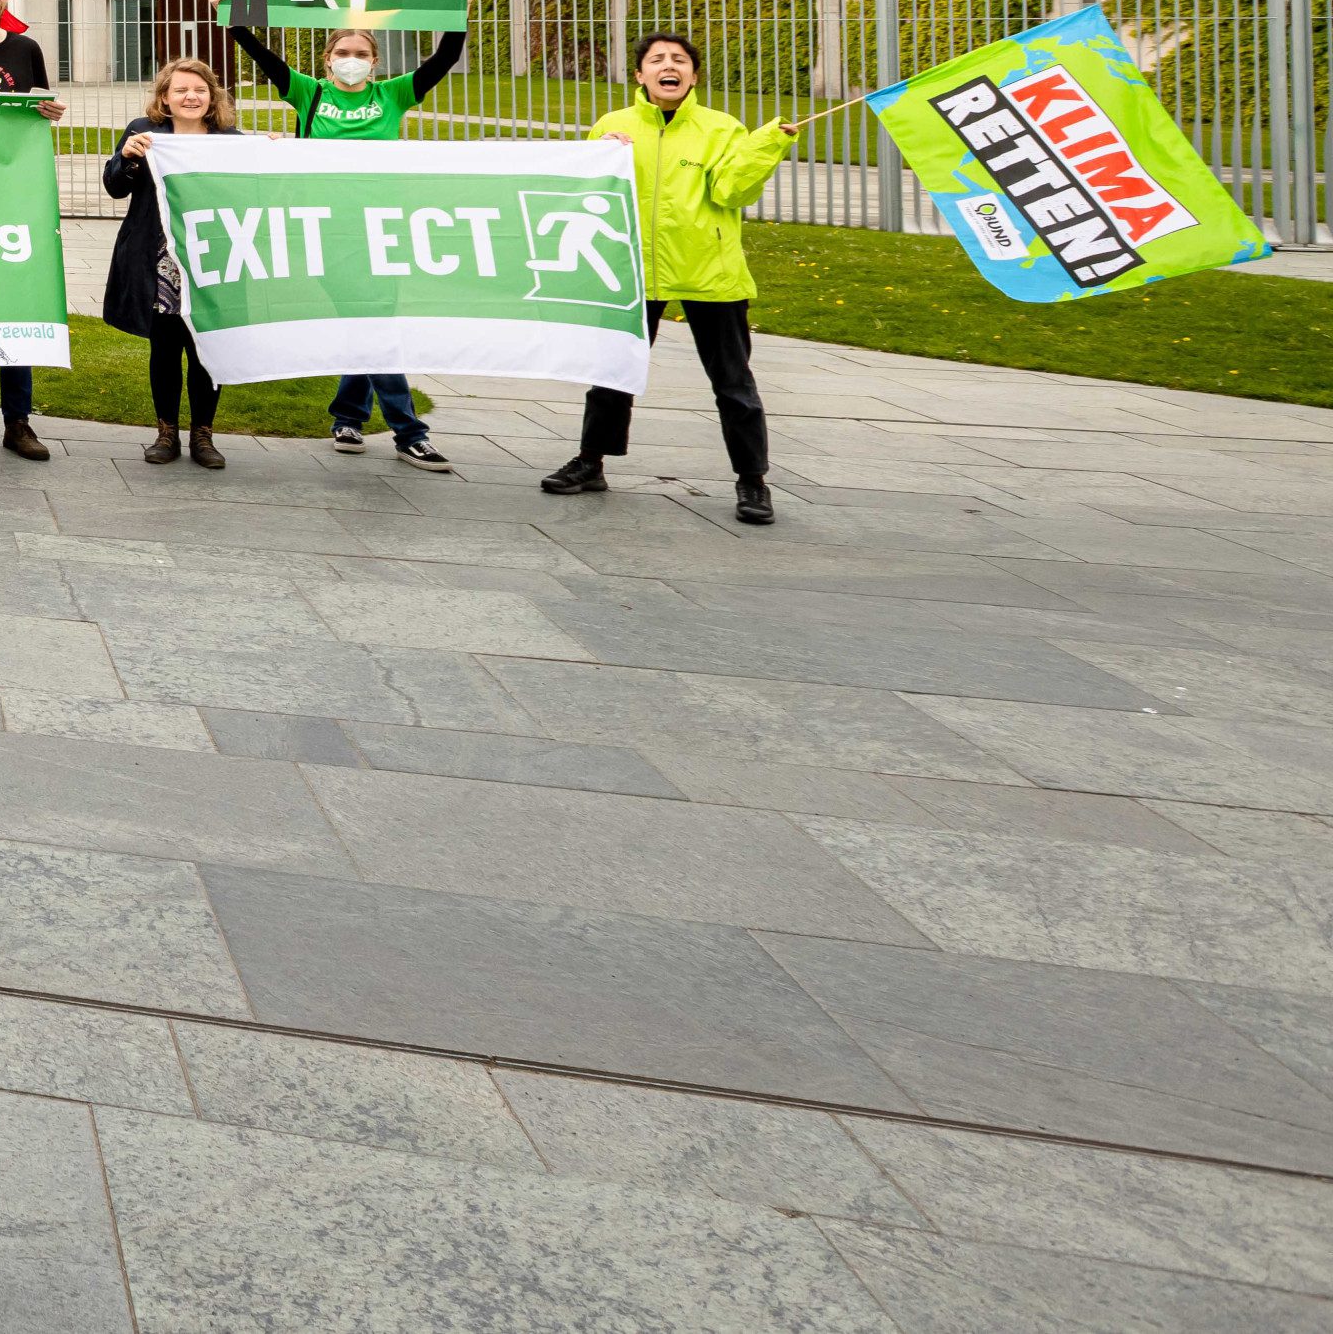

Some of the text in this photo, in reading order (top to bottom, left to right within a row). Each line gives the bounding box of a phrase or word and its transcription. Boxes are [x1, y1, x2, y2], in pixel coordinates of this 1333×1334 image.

[318, 103, 343, 119] EXIT
[936, 82, 1135, 282] RETTEN!
[1011, 74, 1175, 243] KLIMA
[182, 206, 501, 288] EXIT ECT
[982, 216, 1012, 247] BUND
